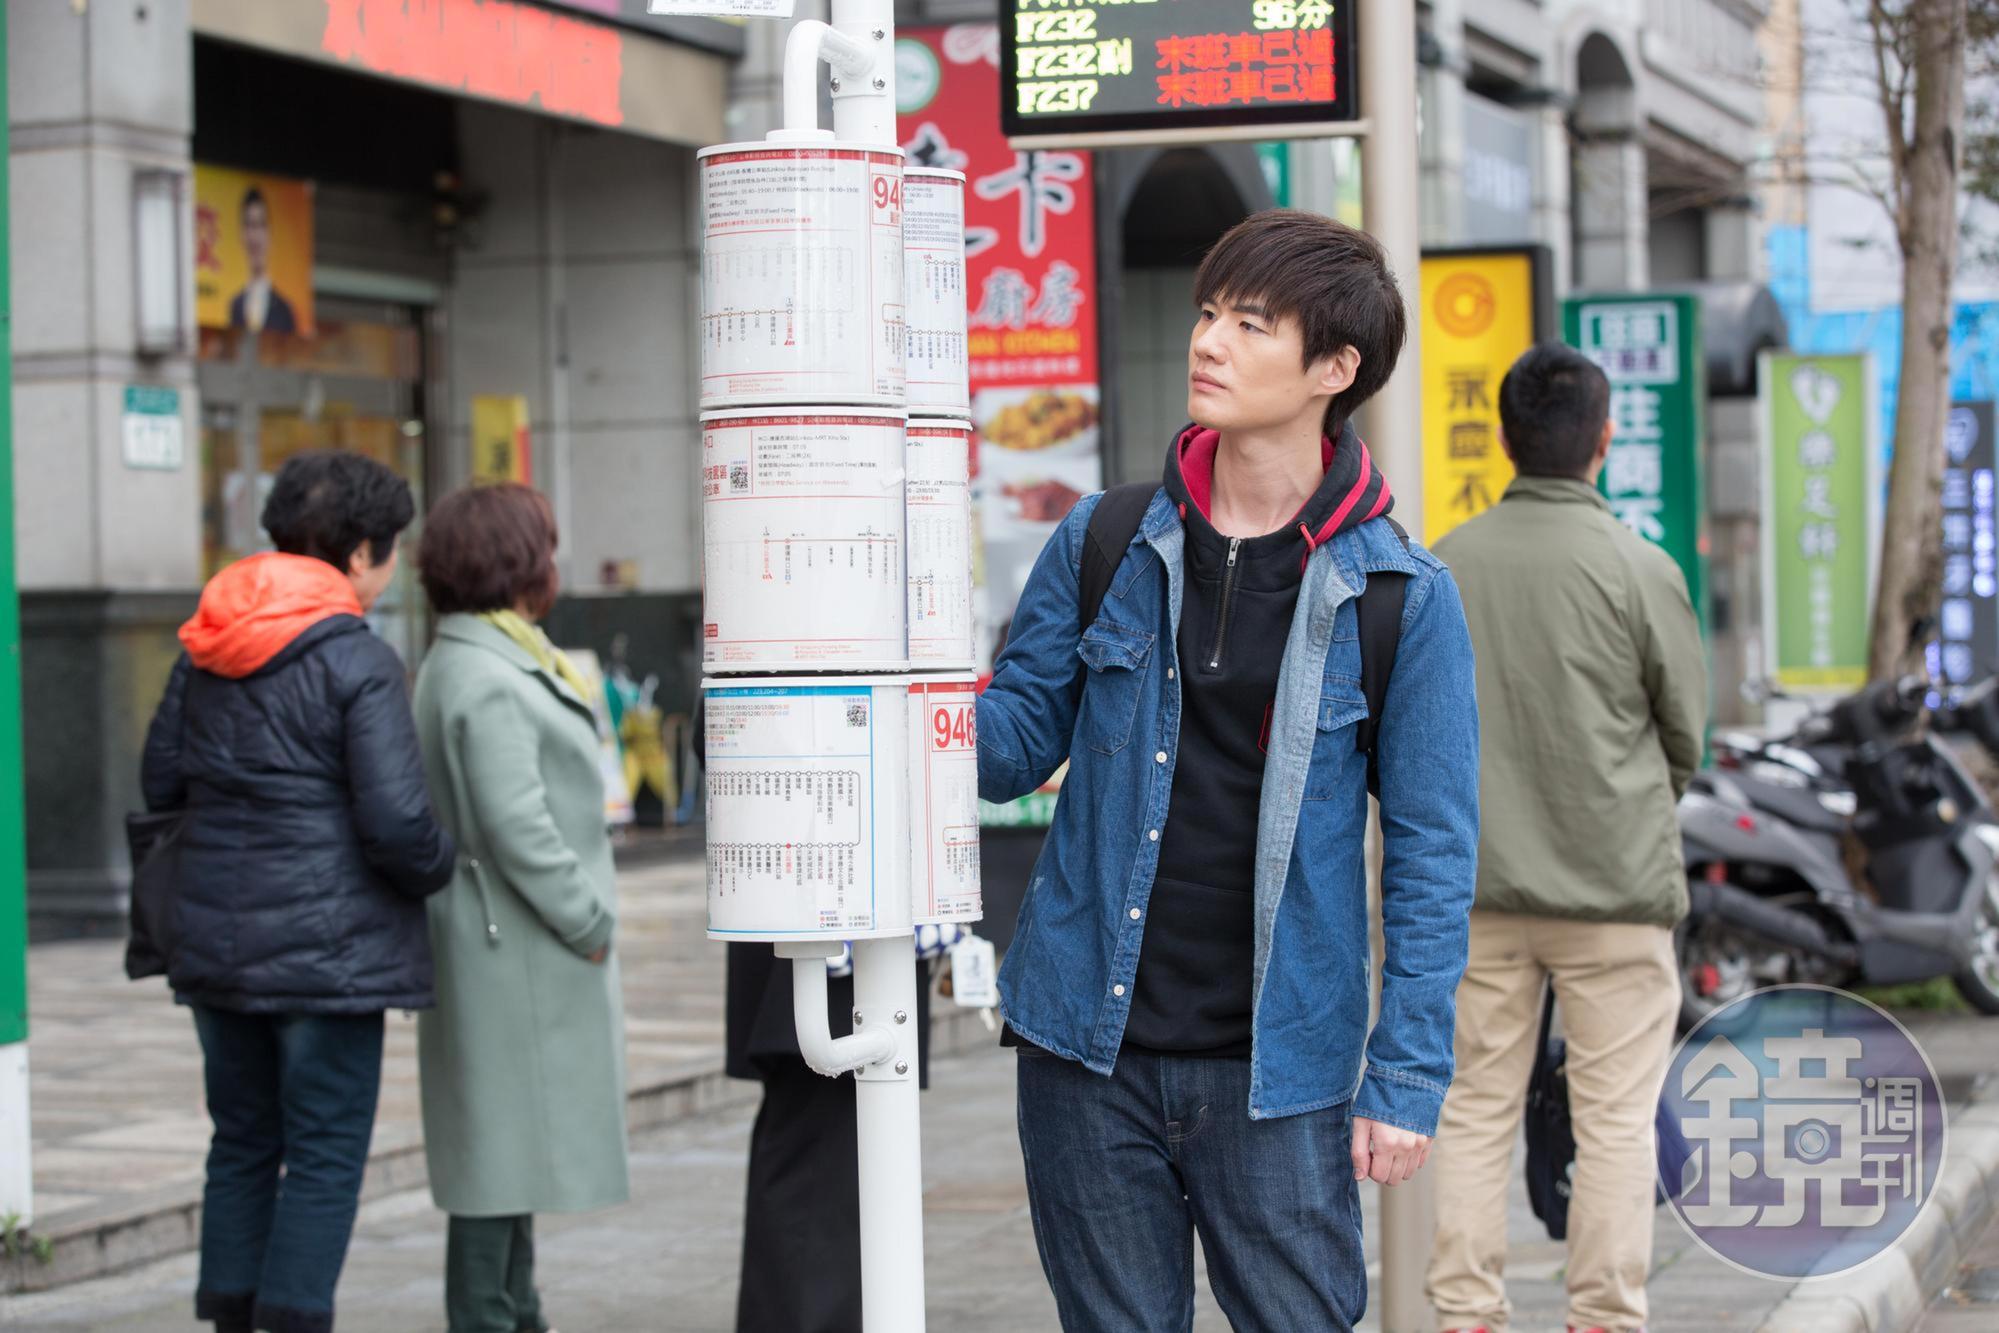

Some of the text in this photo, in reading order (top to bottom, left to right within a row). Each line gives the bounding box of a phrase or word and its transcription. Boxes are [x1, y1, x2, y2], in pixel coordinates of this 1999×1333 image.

[1016, 9, 1097, 42] F232
[1253, 0, 1334, 30] 96分
[1017, 80, 1098, 113] F237
[873, 176, 904, 212] 94
